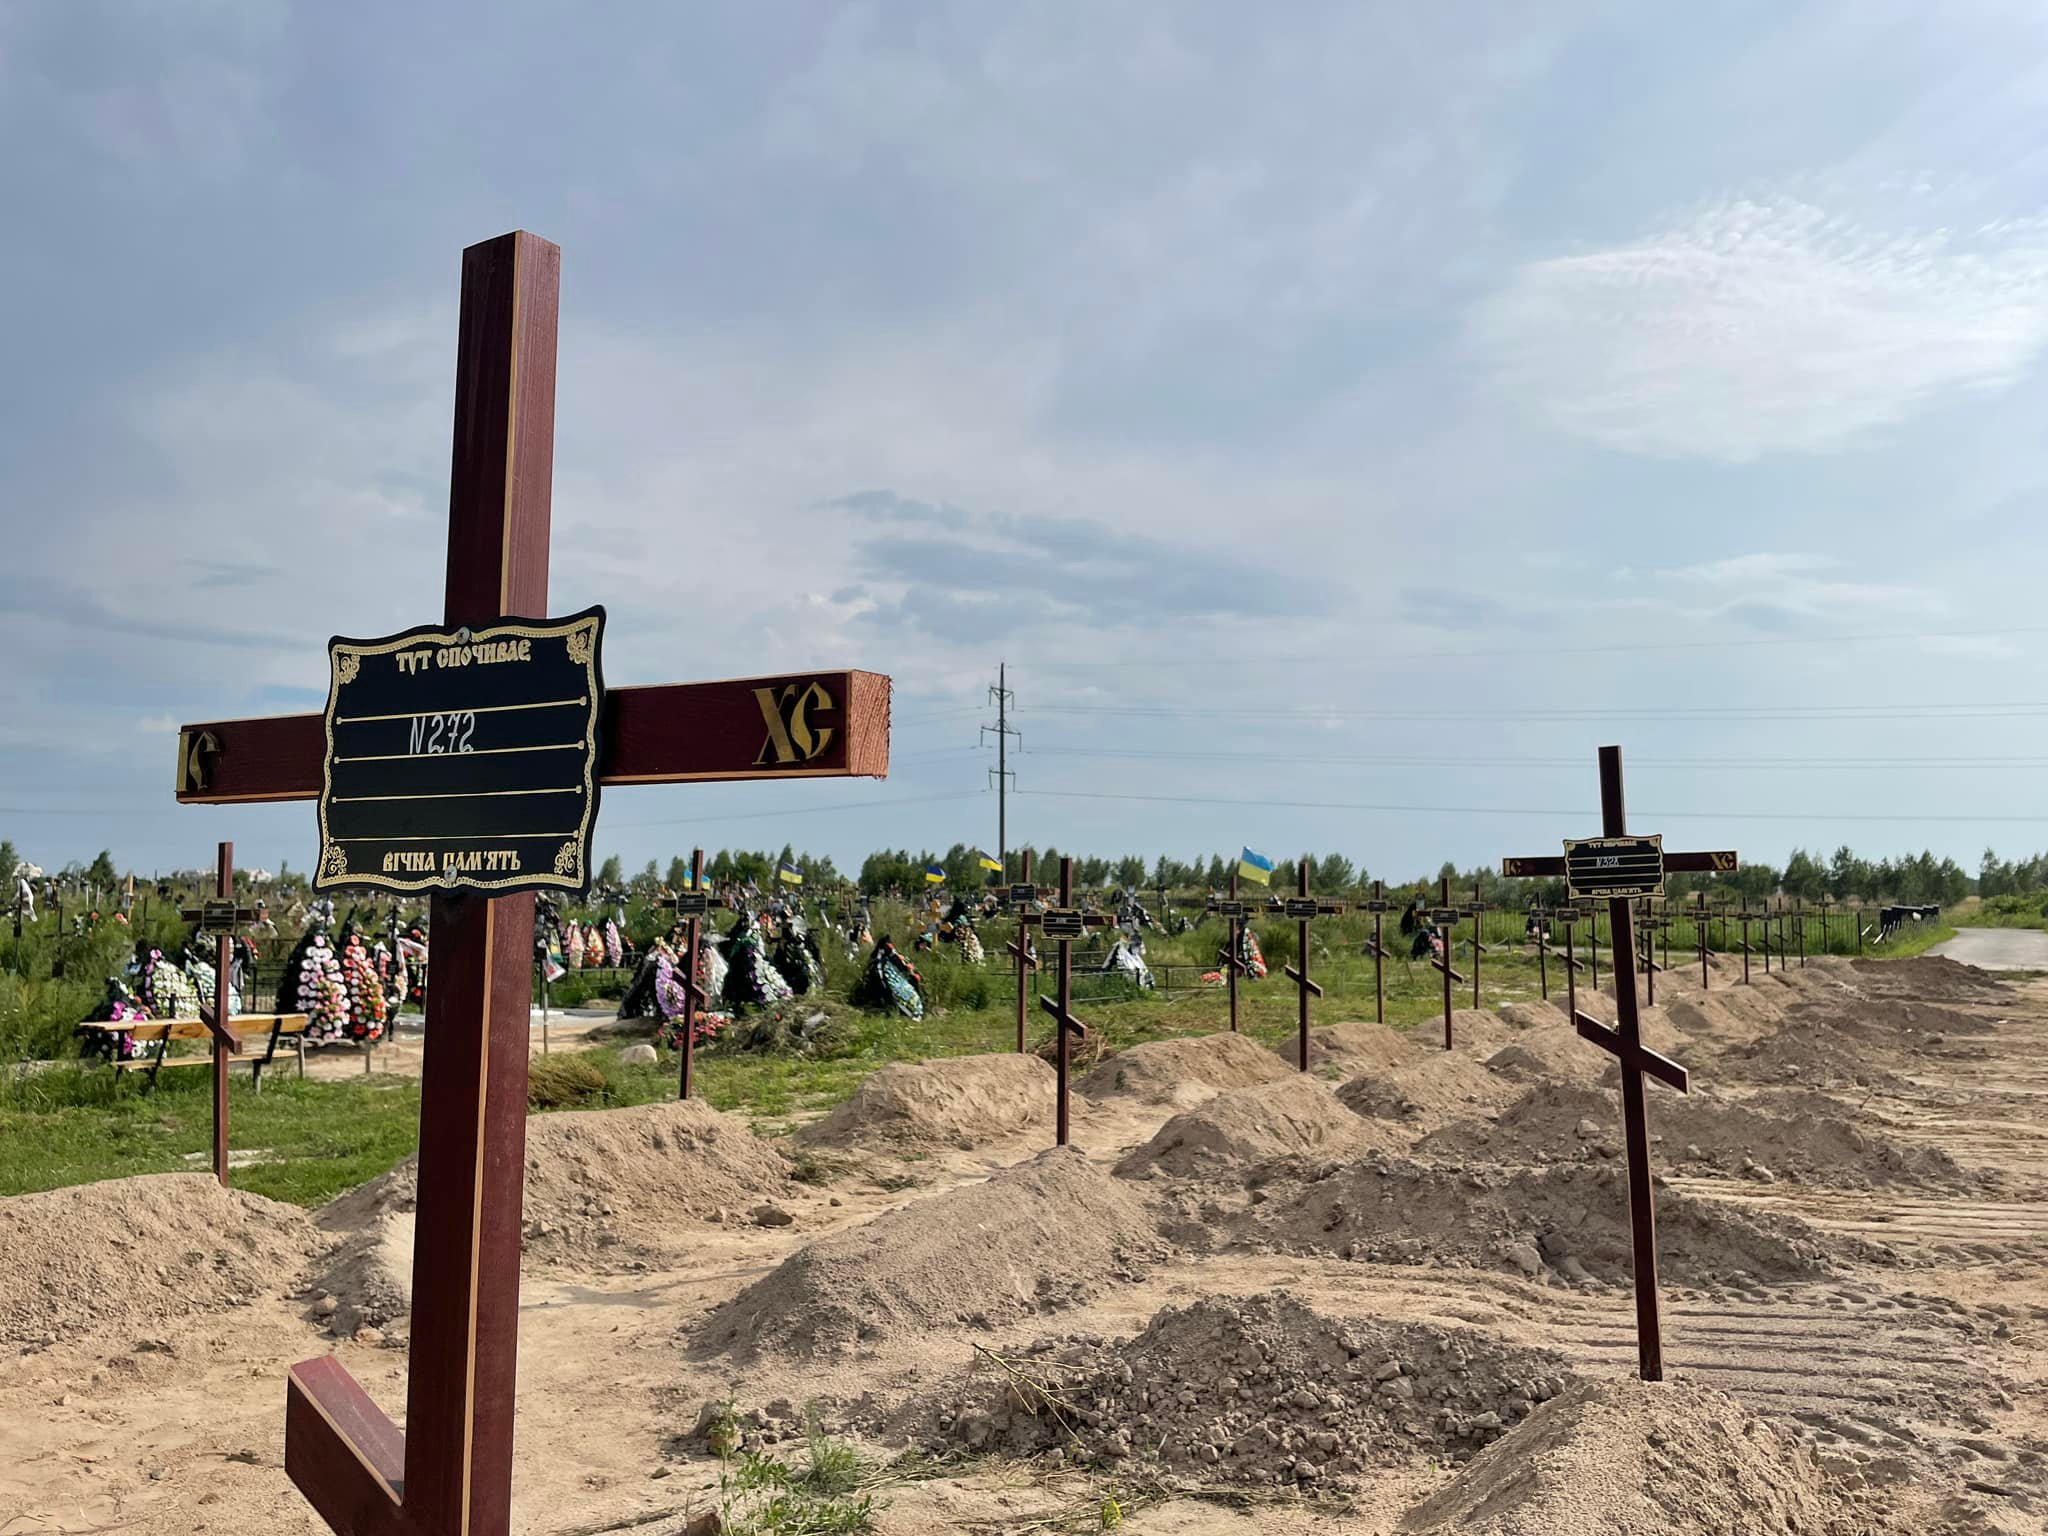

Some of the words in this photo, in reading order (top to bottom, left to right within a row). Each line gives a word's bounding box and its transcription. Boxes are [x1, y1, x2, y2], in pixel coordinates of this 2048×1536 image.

[396, 650, 432, 675] ТУТ
[436, 639, 531, 668] СПОЧИВАЄ
[409, 712, 476, 755] N272
[382, 851, 436, 872] ВІЧНА
[442, 850, 521, 872] ПАМ'ЯТЬ
